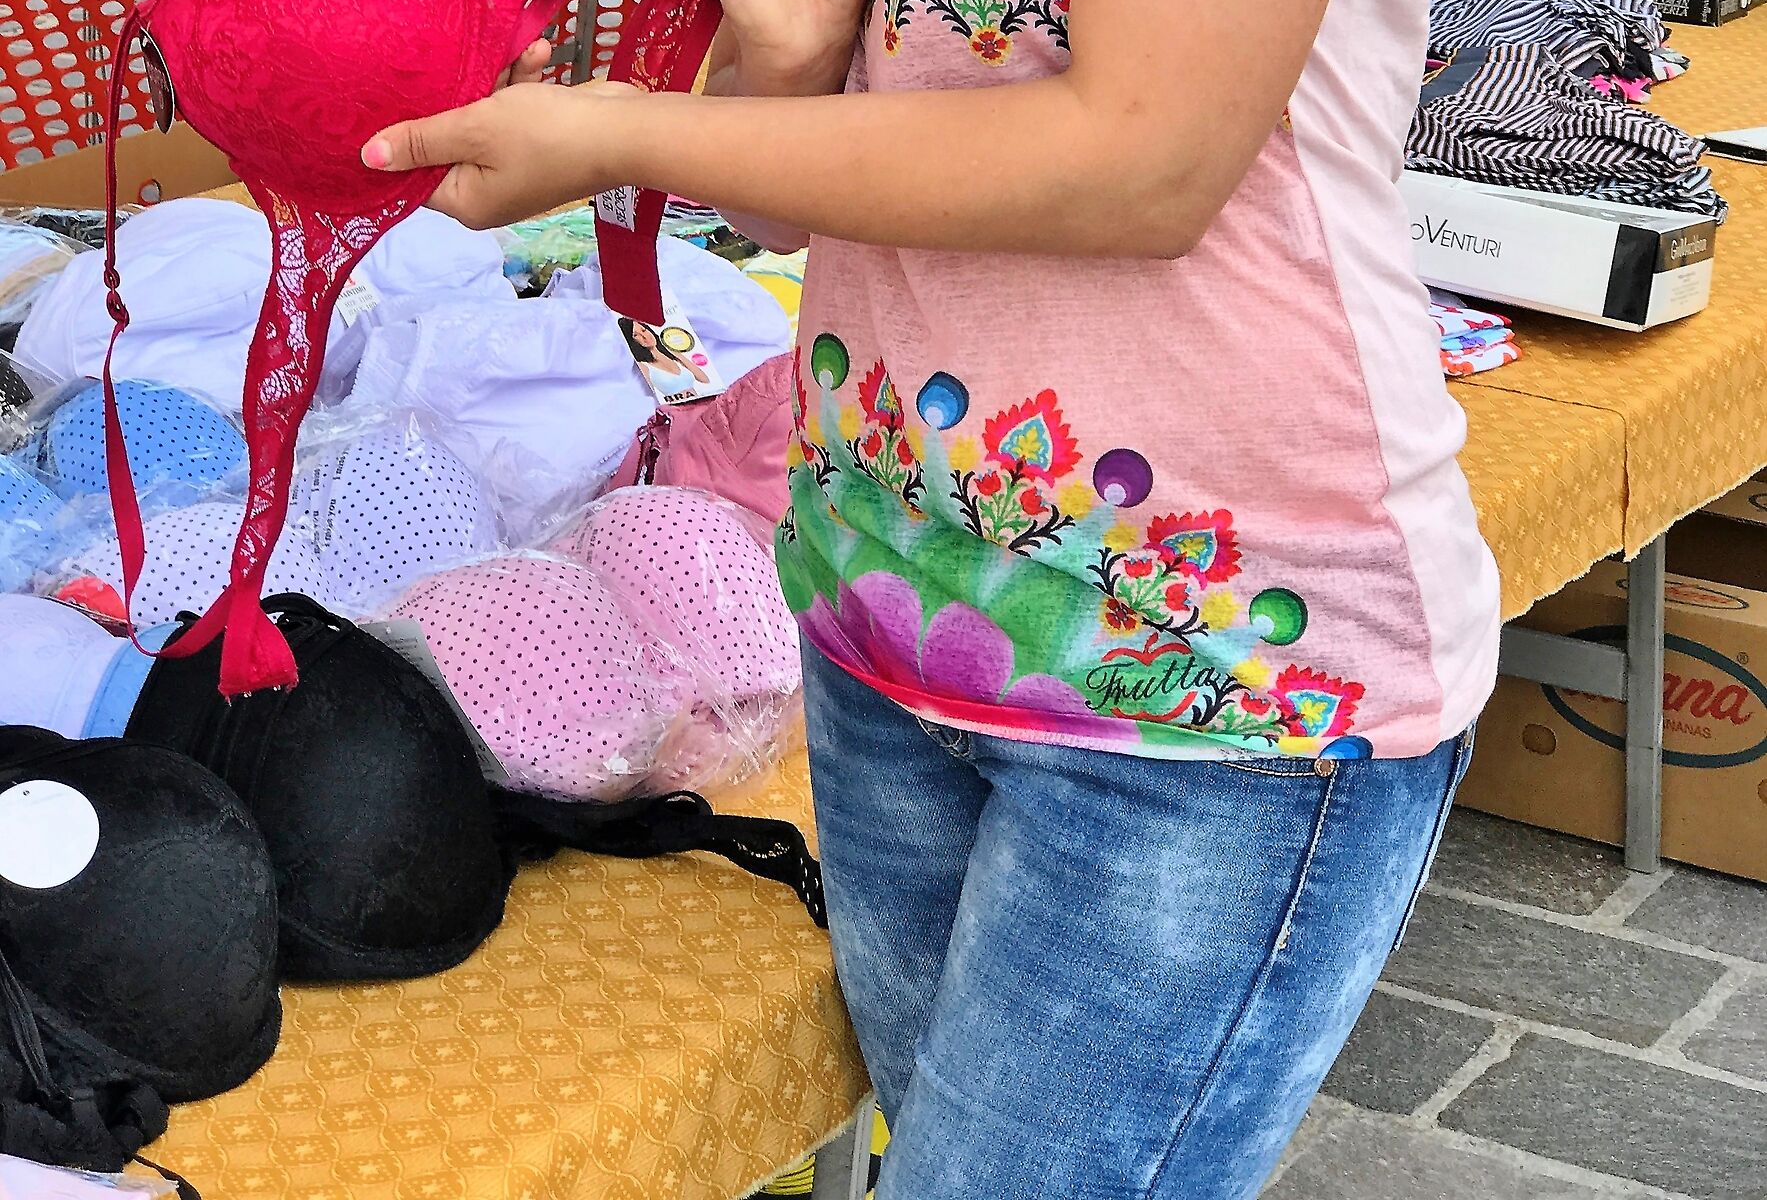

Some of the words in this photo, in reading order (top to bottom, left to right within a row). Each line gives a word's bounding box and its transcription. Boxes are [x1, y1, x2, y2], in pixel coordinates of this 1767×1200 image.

[663, 391, 695, 403] BRA
[1084, 655, 1218, 710] Frutta
[1664, 718, 1711, 739] NANAS
